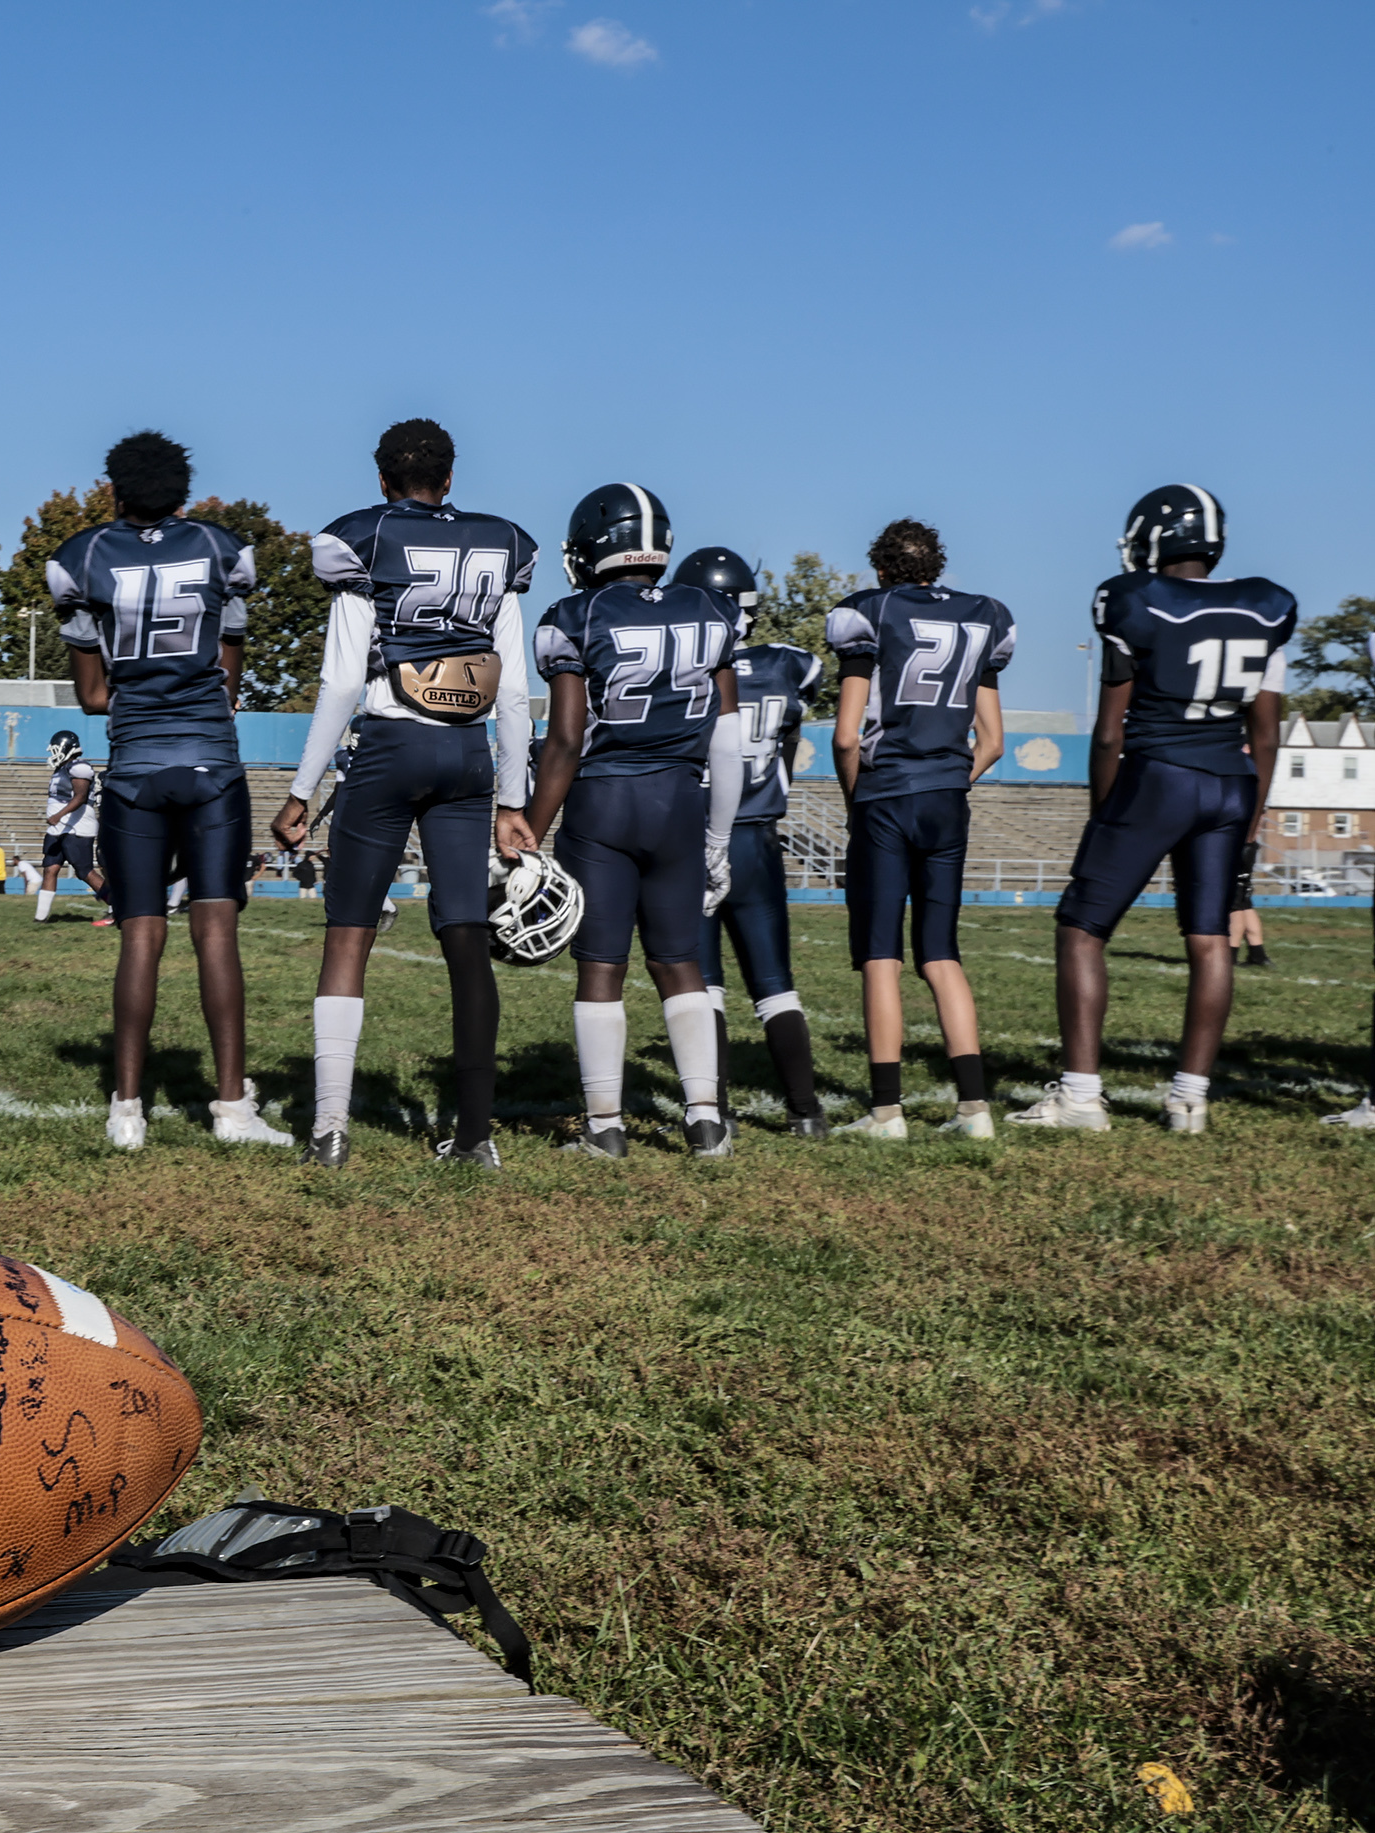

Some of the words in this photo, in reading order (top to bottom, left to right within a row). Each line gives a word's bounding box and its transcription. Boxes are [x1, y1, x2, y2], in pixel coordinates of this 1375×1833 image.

[392, 546, 509, 635] 20
[624, 554, 664, 564] Riddell
[109, 557, 211, 661] 15
[429, 691, 476, 705] BATTLE
[598, 621, 728, 724] 24
[894, 618, 991, 708] 21
[1187, 638, 1268, 720] 15
